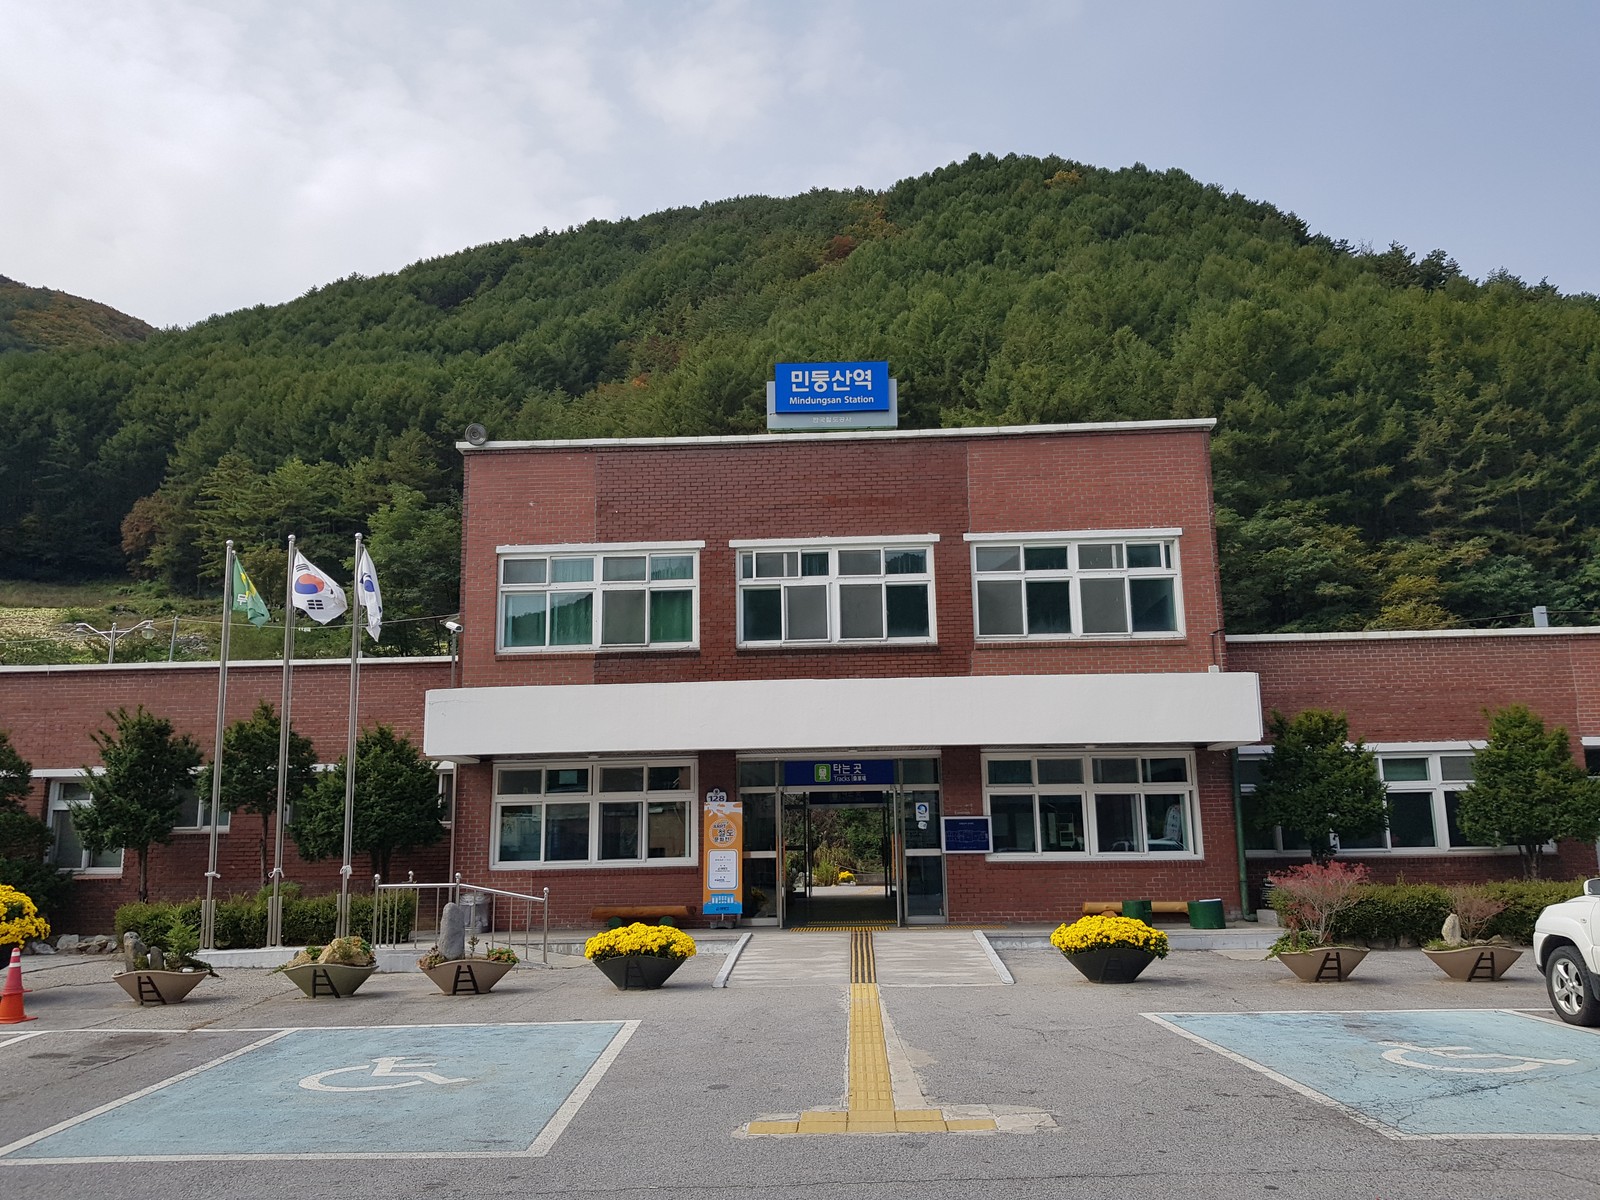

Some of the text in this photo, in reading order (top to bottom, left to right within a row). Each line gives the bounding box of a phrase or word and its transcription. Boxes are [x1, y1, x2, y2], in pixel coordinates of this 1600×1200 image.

[791, 369, 872, 392] 민둥산역
[789, 395, 874, 406] Mindungsan Station
[833, 763, 862, 774] 타는 곳
